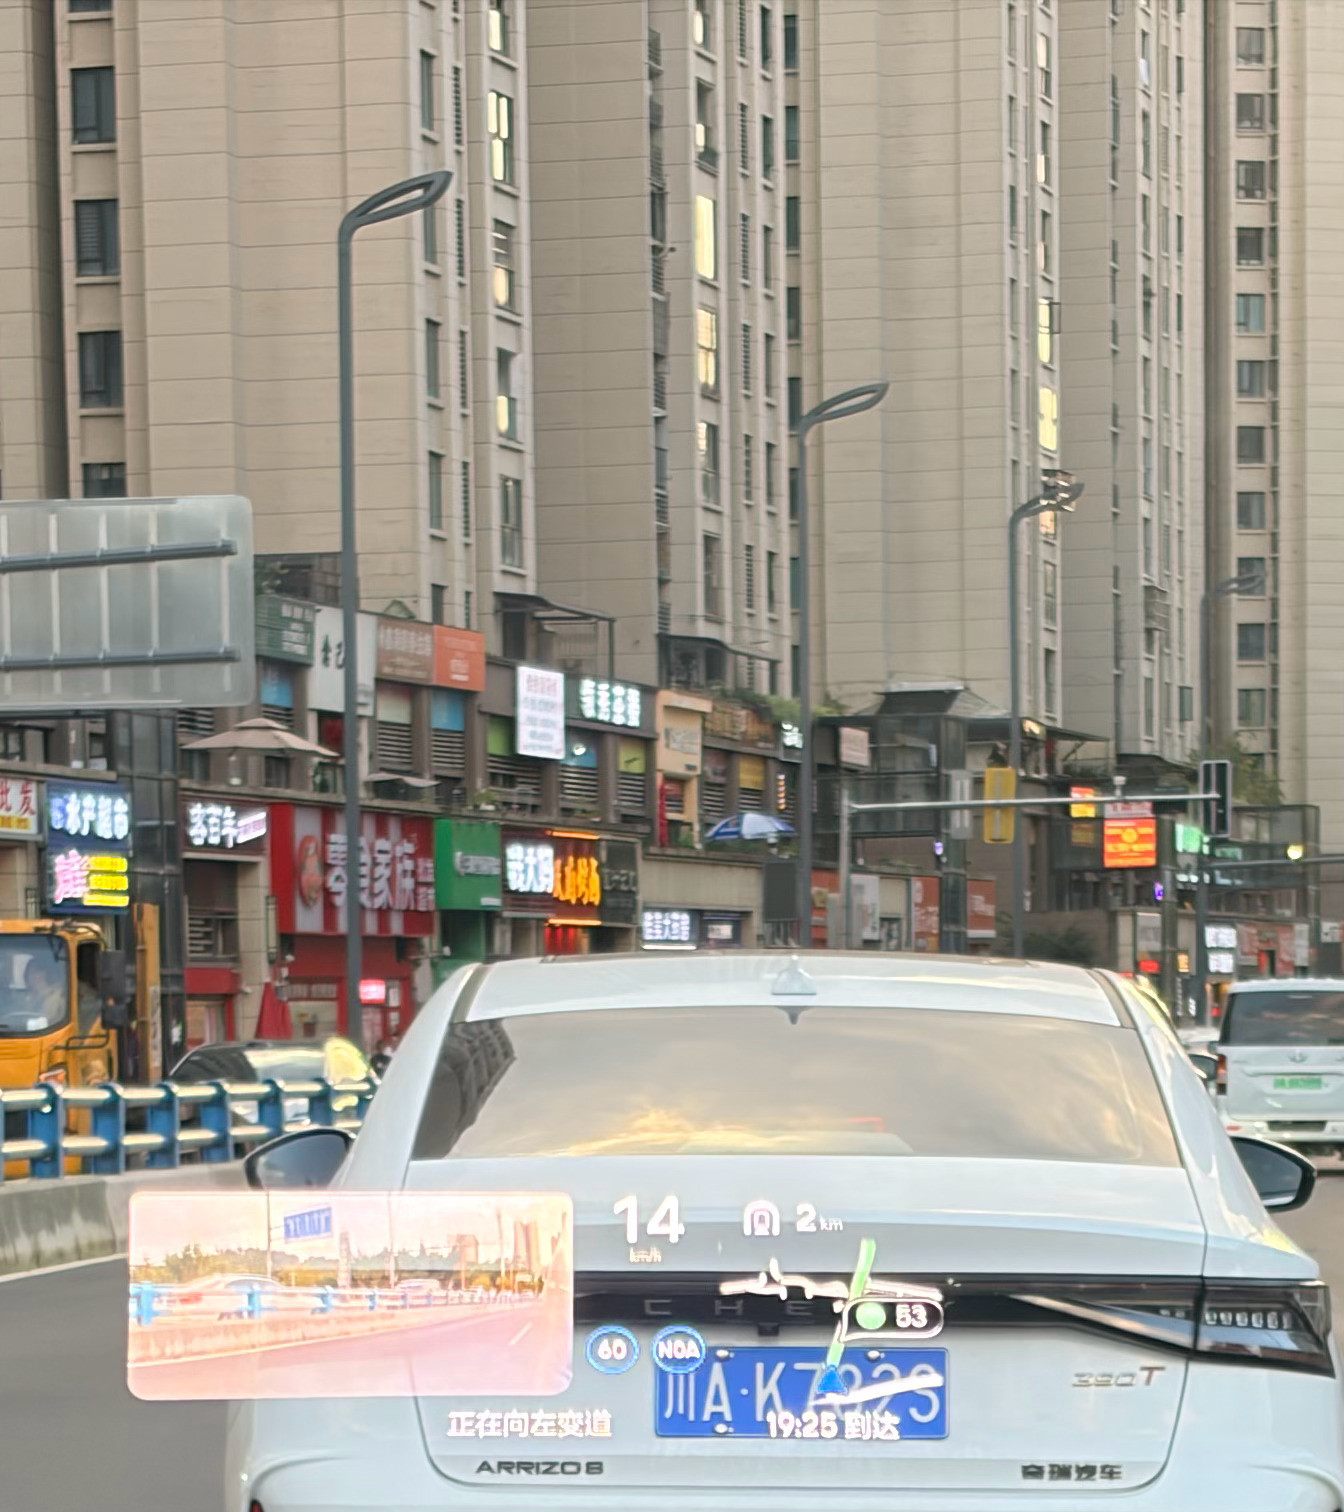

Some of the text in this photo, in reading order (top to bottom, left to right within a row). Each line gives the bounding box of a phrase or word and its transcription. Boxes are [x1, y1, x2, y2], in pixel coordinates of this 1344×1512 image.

[613, 1195, 685, 1243] 14
[796, 1203, 844, 1232] 2 km
[629, 1247, 662, 1264] km/h
[895, 1304, 927, 1328] 53
[598, 1339, 627, 1360] 60
[657, 1339, 701, 1360] NOA
[447, 1408, 612, 1438] 正在向左变道
[765, 1410, 901, 1440] 19:25 到达
[475, 1460, 604, 1475] ARRIZO 8
